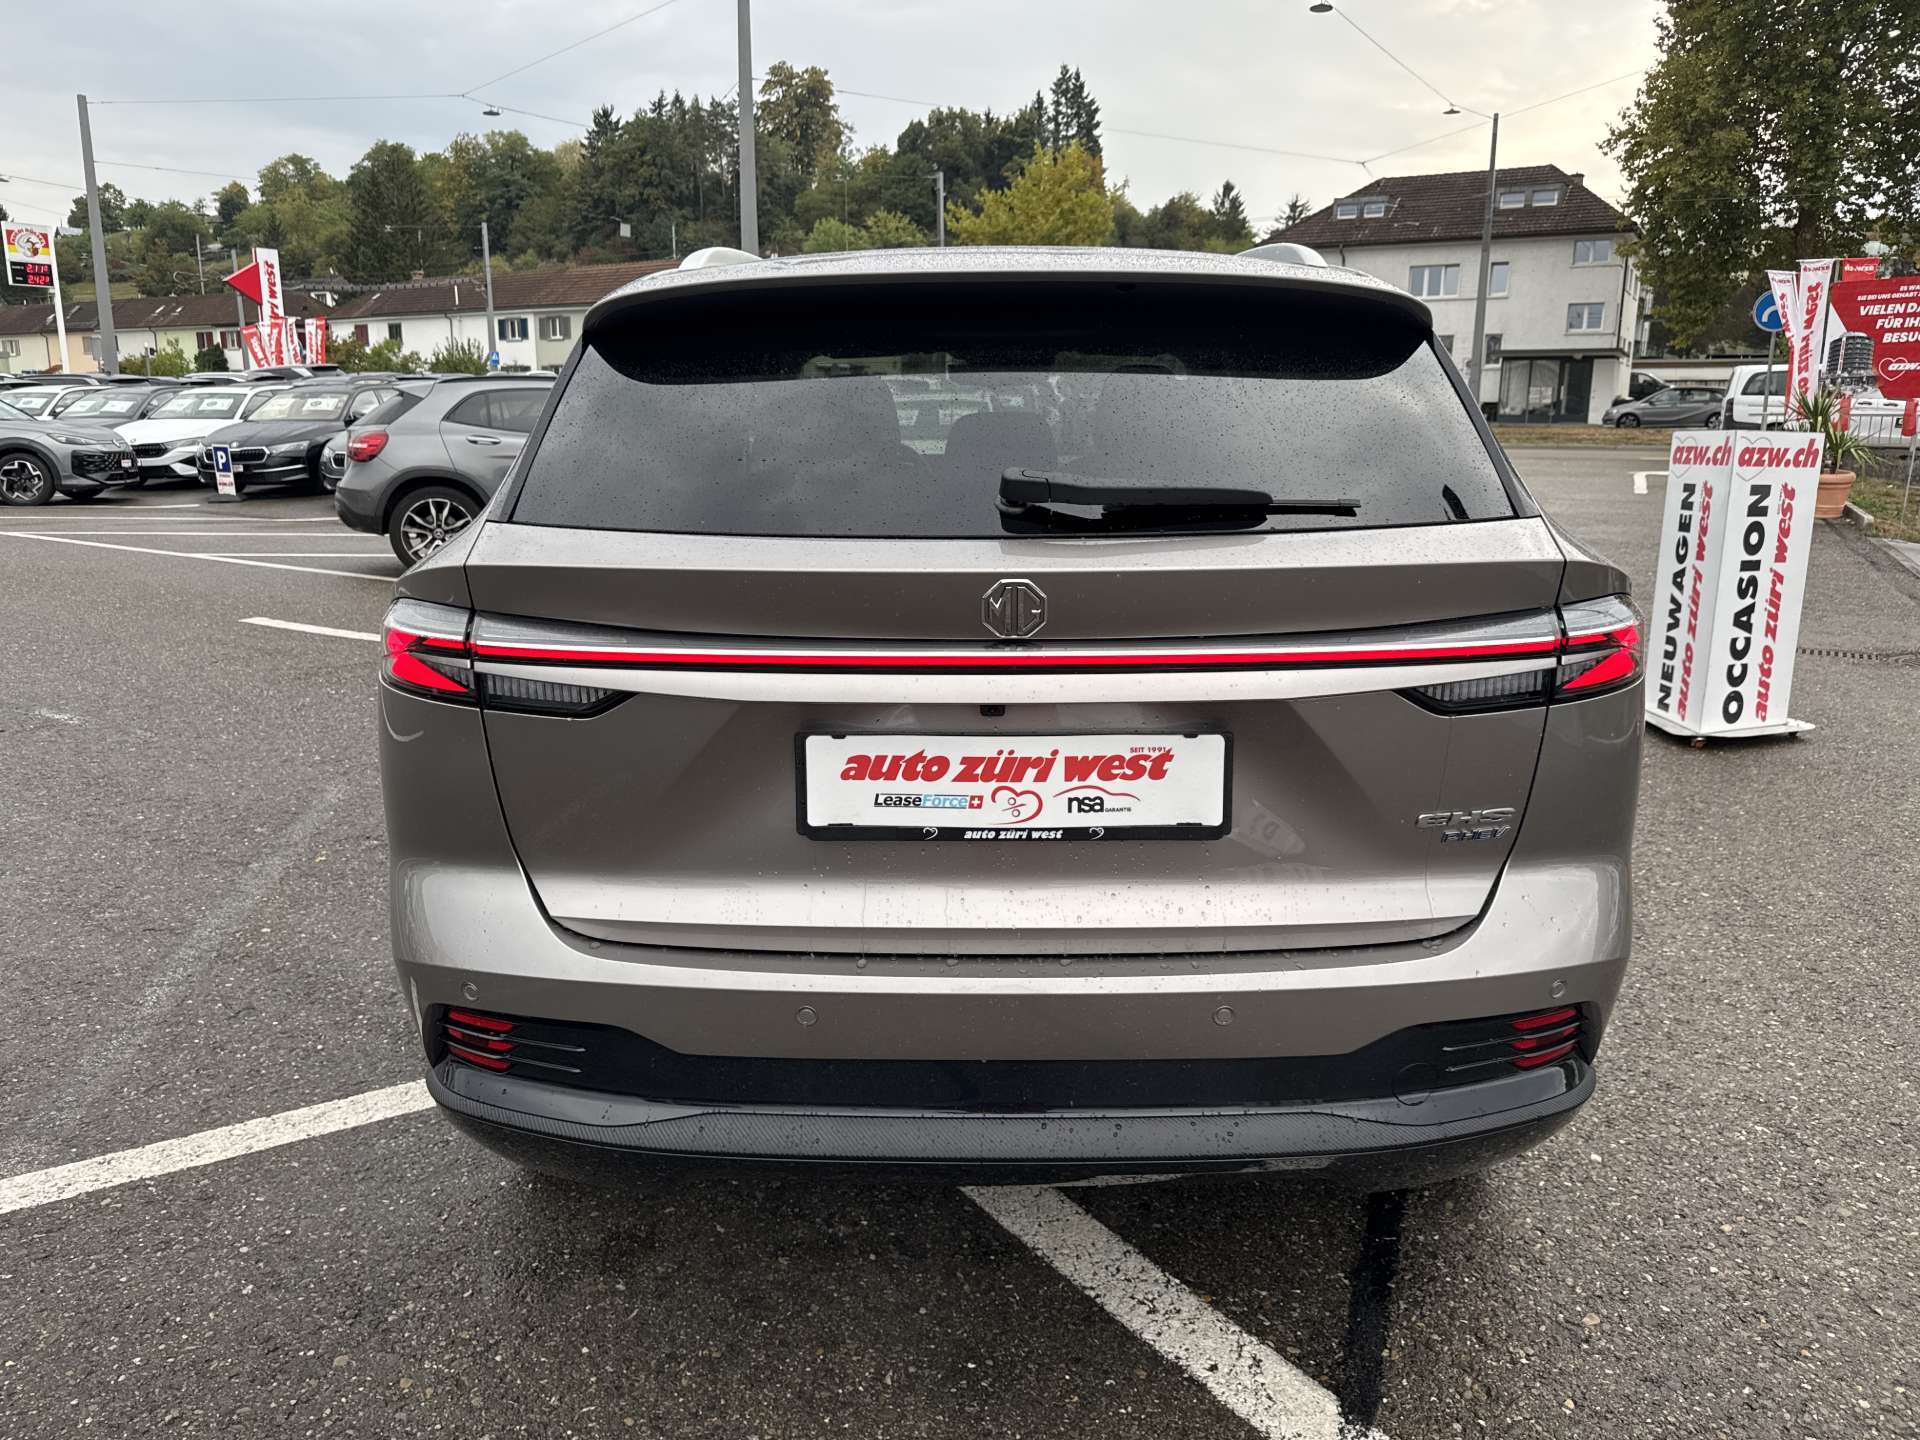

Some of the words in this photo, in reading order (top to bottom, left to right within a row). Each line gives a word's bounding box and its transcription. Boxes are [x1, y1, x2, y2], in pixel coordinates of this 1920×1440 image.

[264, 260, 277, 299] west
[1860, 303, 1905, 316] VIELEN
[1891, 291, 1917, 299] GEHABT
[1876, 316, 1903, 330] FÜR
[1904, 317, 1920, 328] IH
[1882, 331, 1920, 343] BESU
[217, 450, 226, 469] P
[1672, 436, 1732, 466] azw.ch
[1738, 438, 1820, 468] azw.ch
[1774, 482, 1795, 563] west
[987, 586, 1041, 635] MG
[1657, 483, 1696, 713] NEUWAGEN
[1677, 642, 1694, 721] auto
[1687, 564, 1703, 642] züri
[1696, 480, 1713, 561] west
[1722, 485, 1772, 724] OCCASION
[1764, 567, 1784, 644] züri
[1755, 644, 1774, 722] auto
[840, 749, 951, 782] auto
[952, 749, 1059, 783] züri
[1064, 748, 1175, 782] west
[874, 793, 968, 808] LeaseForce
[1067, 796, 1104, 813] nsa
[964, 829, 996, 839] auto
[998, 829, 1028, 839] züri
[1031, 829, 1064, 839] west
[1440, 825, 1511, 843] PHEV
